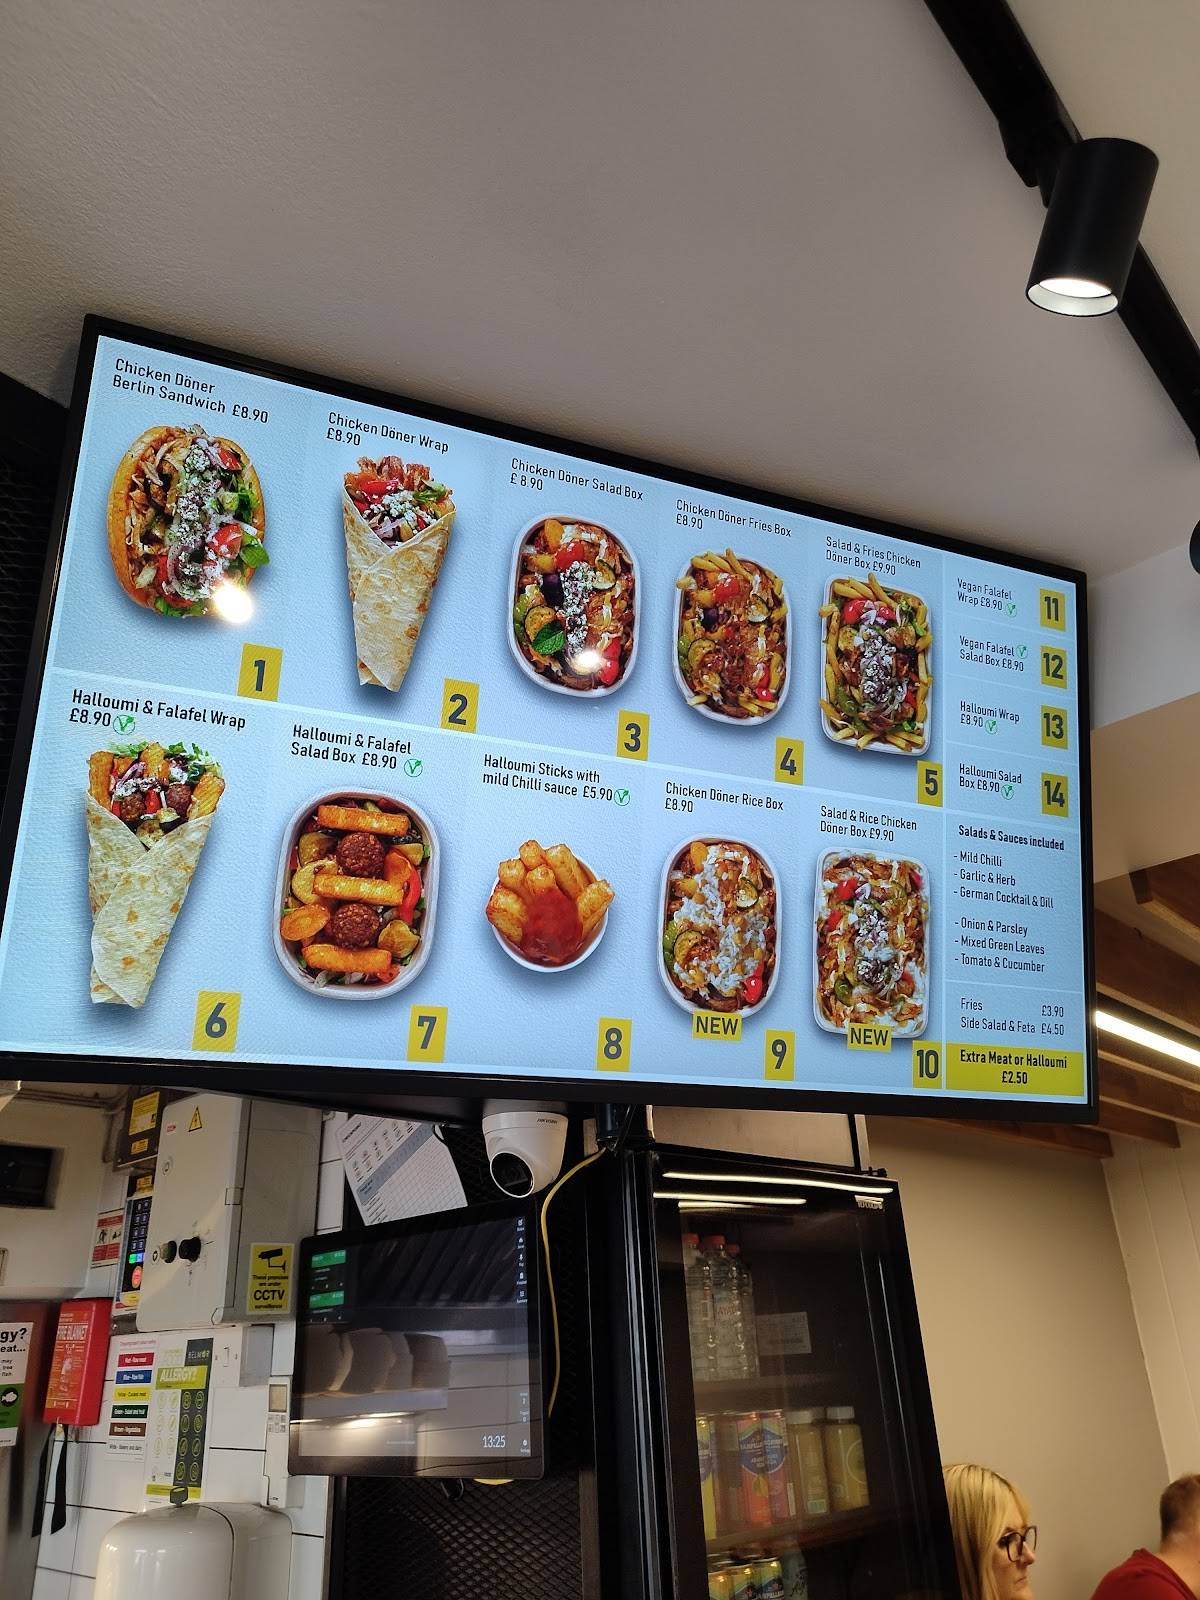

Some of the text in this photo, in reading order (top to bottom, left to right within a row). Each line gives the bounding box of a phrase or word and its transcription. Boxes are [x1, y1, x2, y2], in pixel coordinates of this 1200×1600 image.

[115, 358, 215, 393] Chicken Döner
[113, 375, 268, 424] Berlin Sandwich £8.90
[326, 427, 361, 446] £8.90
[328, 412, 449, 454] Chicken Döner Wrap
[511, 458, 643, 501] Chicken Döner Salad Box
[676, 499, 791, 537] Chicken Döner Fries Box
[676, 513, 703, 529] £8.90
[826, 536, 921, 569] Salad & Fries Chicken
[826, 549, 896, 575] Döner Box £9.90
[957, 578, 1012, 600] Vegan Falafel
[957, 591, 1003, 611] Wrap £8.90
[1044, 596, 1059, 622] 11
[959, 635, 1015, 657] Vegan Falafel
[959, 649, 1024, 672] Salad Box £8.90
[1043, 653, 1064, 680] 12
[253, 659, 266, 692] 1
[68, 707, 112, 727] £8.90
[72, 689, 246, 732] Halloumi & Falafel Wrap
[448, 693, 468, 726] 2
[960, 700, 1020, 724] Halloumi Wrap
[960, 713, 983, 728] £8.90
[623, 722, 642, 752] 3
[1043, 712, 1064, 739] 13
[293, 724, 411, 754] Halloumi & Falafel
[291, 741, 397, 770] Salad Box £8.90
[484, 753, 600, 784] Halloumi Sticks with
[780, 747, 797, 776] 4
[482, 772, 613, 801] mild Chilli sauce £5.90
[924, 768, 939, 796] 5
[959, 763, 1022, 784] Halloumi Salad
[959, 776, 1000, 793] Box £8.90
[664, 797, 694, 813] £8.90
[666, 781, 784, 811] Chicken Döner Rice Box
[1044, 780, 1065, 808] 14
[820, 820, 894, 842] Döner Box £9.90
[821, 805, 917, 831] Salad & Rice Chicken
[958, 825, 1065, 851] Salads & Sauces included
[960, 851, 978, 864] Mild
[980, 853, 1002, 867] Chilli
[960, 868, 986, 883] Garlic
[987, 872, 994, 883] &
[996, 873, 1016, 886] Herb
[960, 886, 994, 901] German
[996, 891, 1030, 906] Cocktail
[1032, 895, 1038, 907] &
[1040, 896, 1054, 909] Dill
[961, 917, 986, 931] Onion
[987, 920, 994, 931] &
[996, 920, 1028, 938] Parsley
[961, 935, 986, 949] Mixed
[988, 937, 1014, 952] Green
[1015, 941, 1045, 955] Leaves
[961, 953, 992, 967] Tomato
[994, 956, 1001, 968] &
[1002, 957, 1045, 973] Cucumber
[204, 1002, 227, 1039] 6
[960, 998, 1064, 1018] Fries £3.90
[417, 1015, 437, 1050] 7
[695, 1015, 739, 1036] NEW
[849, 1027, 889, 1046] NEW
[960, 1017, 1065, 1036] Side Salad & Feta £4.50
[603, 1027, 623, 1060] 8
[771, 1038, 787, 1070] 9
[916, 1049, 939, 1079] 10
[960, 1049, 1067, 1069] Extra Meat or Halloumi
[1001, 1071, 1028, 1085] £2.50
[253, 1289, 285, 1301] CCTV
[159, 1366, 197, 1382] ALLERGY?
[482, 1435, 506, 1448] 13:25
